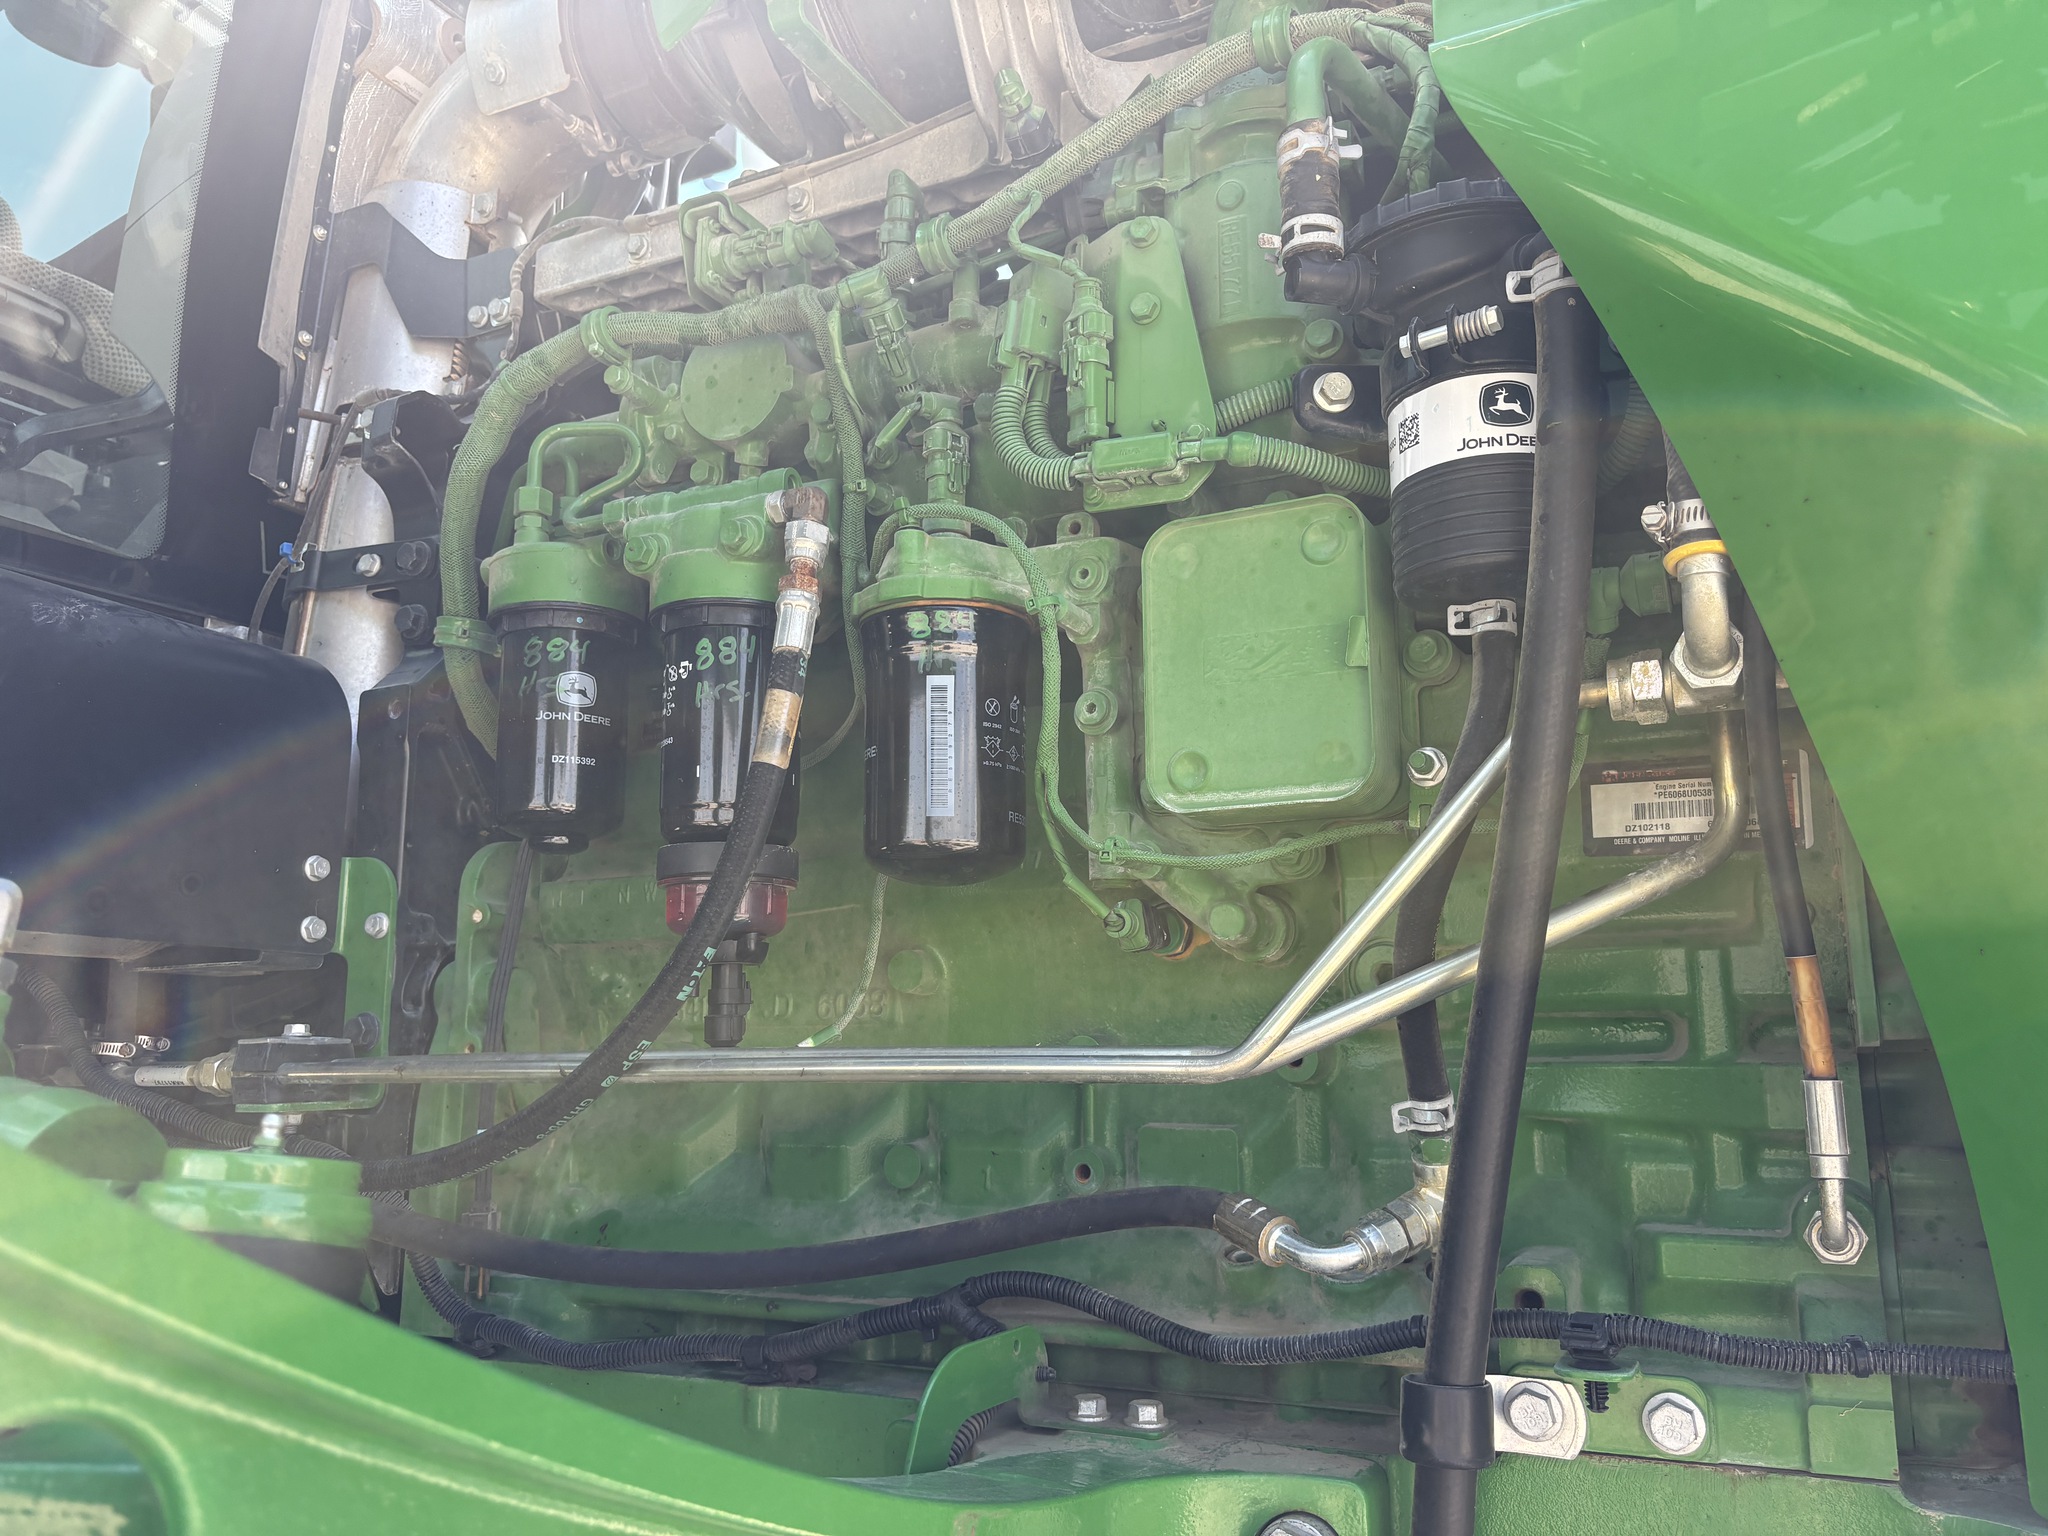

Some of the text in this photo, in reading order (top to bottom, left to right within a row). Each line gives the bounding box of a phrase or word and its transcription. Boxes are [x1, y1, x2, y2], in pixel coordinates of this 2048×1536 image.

[1457, 433, 1536, 452] JOHN DEE
[524, 635, 591, 668] 884
[695, 635, 756, 671] 884
[535, 710, 612, 727] JOHN DEERE
[551, 754, 597, 766] DZ115392
[864, 745, 878, 761] ERE
[1654, 789, 1715, 799] PE6068U0538
[1655, 783, 1676, 791] Engine
[1625, 823, 1671, 833] DZ102118
[1613, 838, 1631, 846] DEERE
[1639, 836, 1665, 845] COMPANY
[1668, 834, 1690, 843] MOLINE
[622, 1039, 653, 1072] ESP
